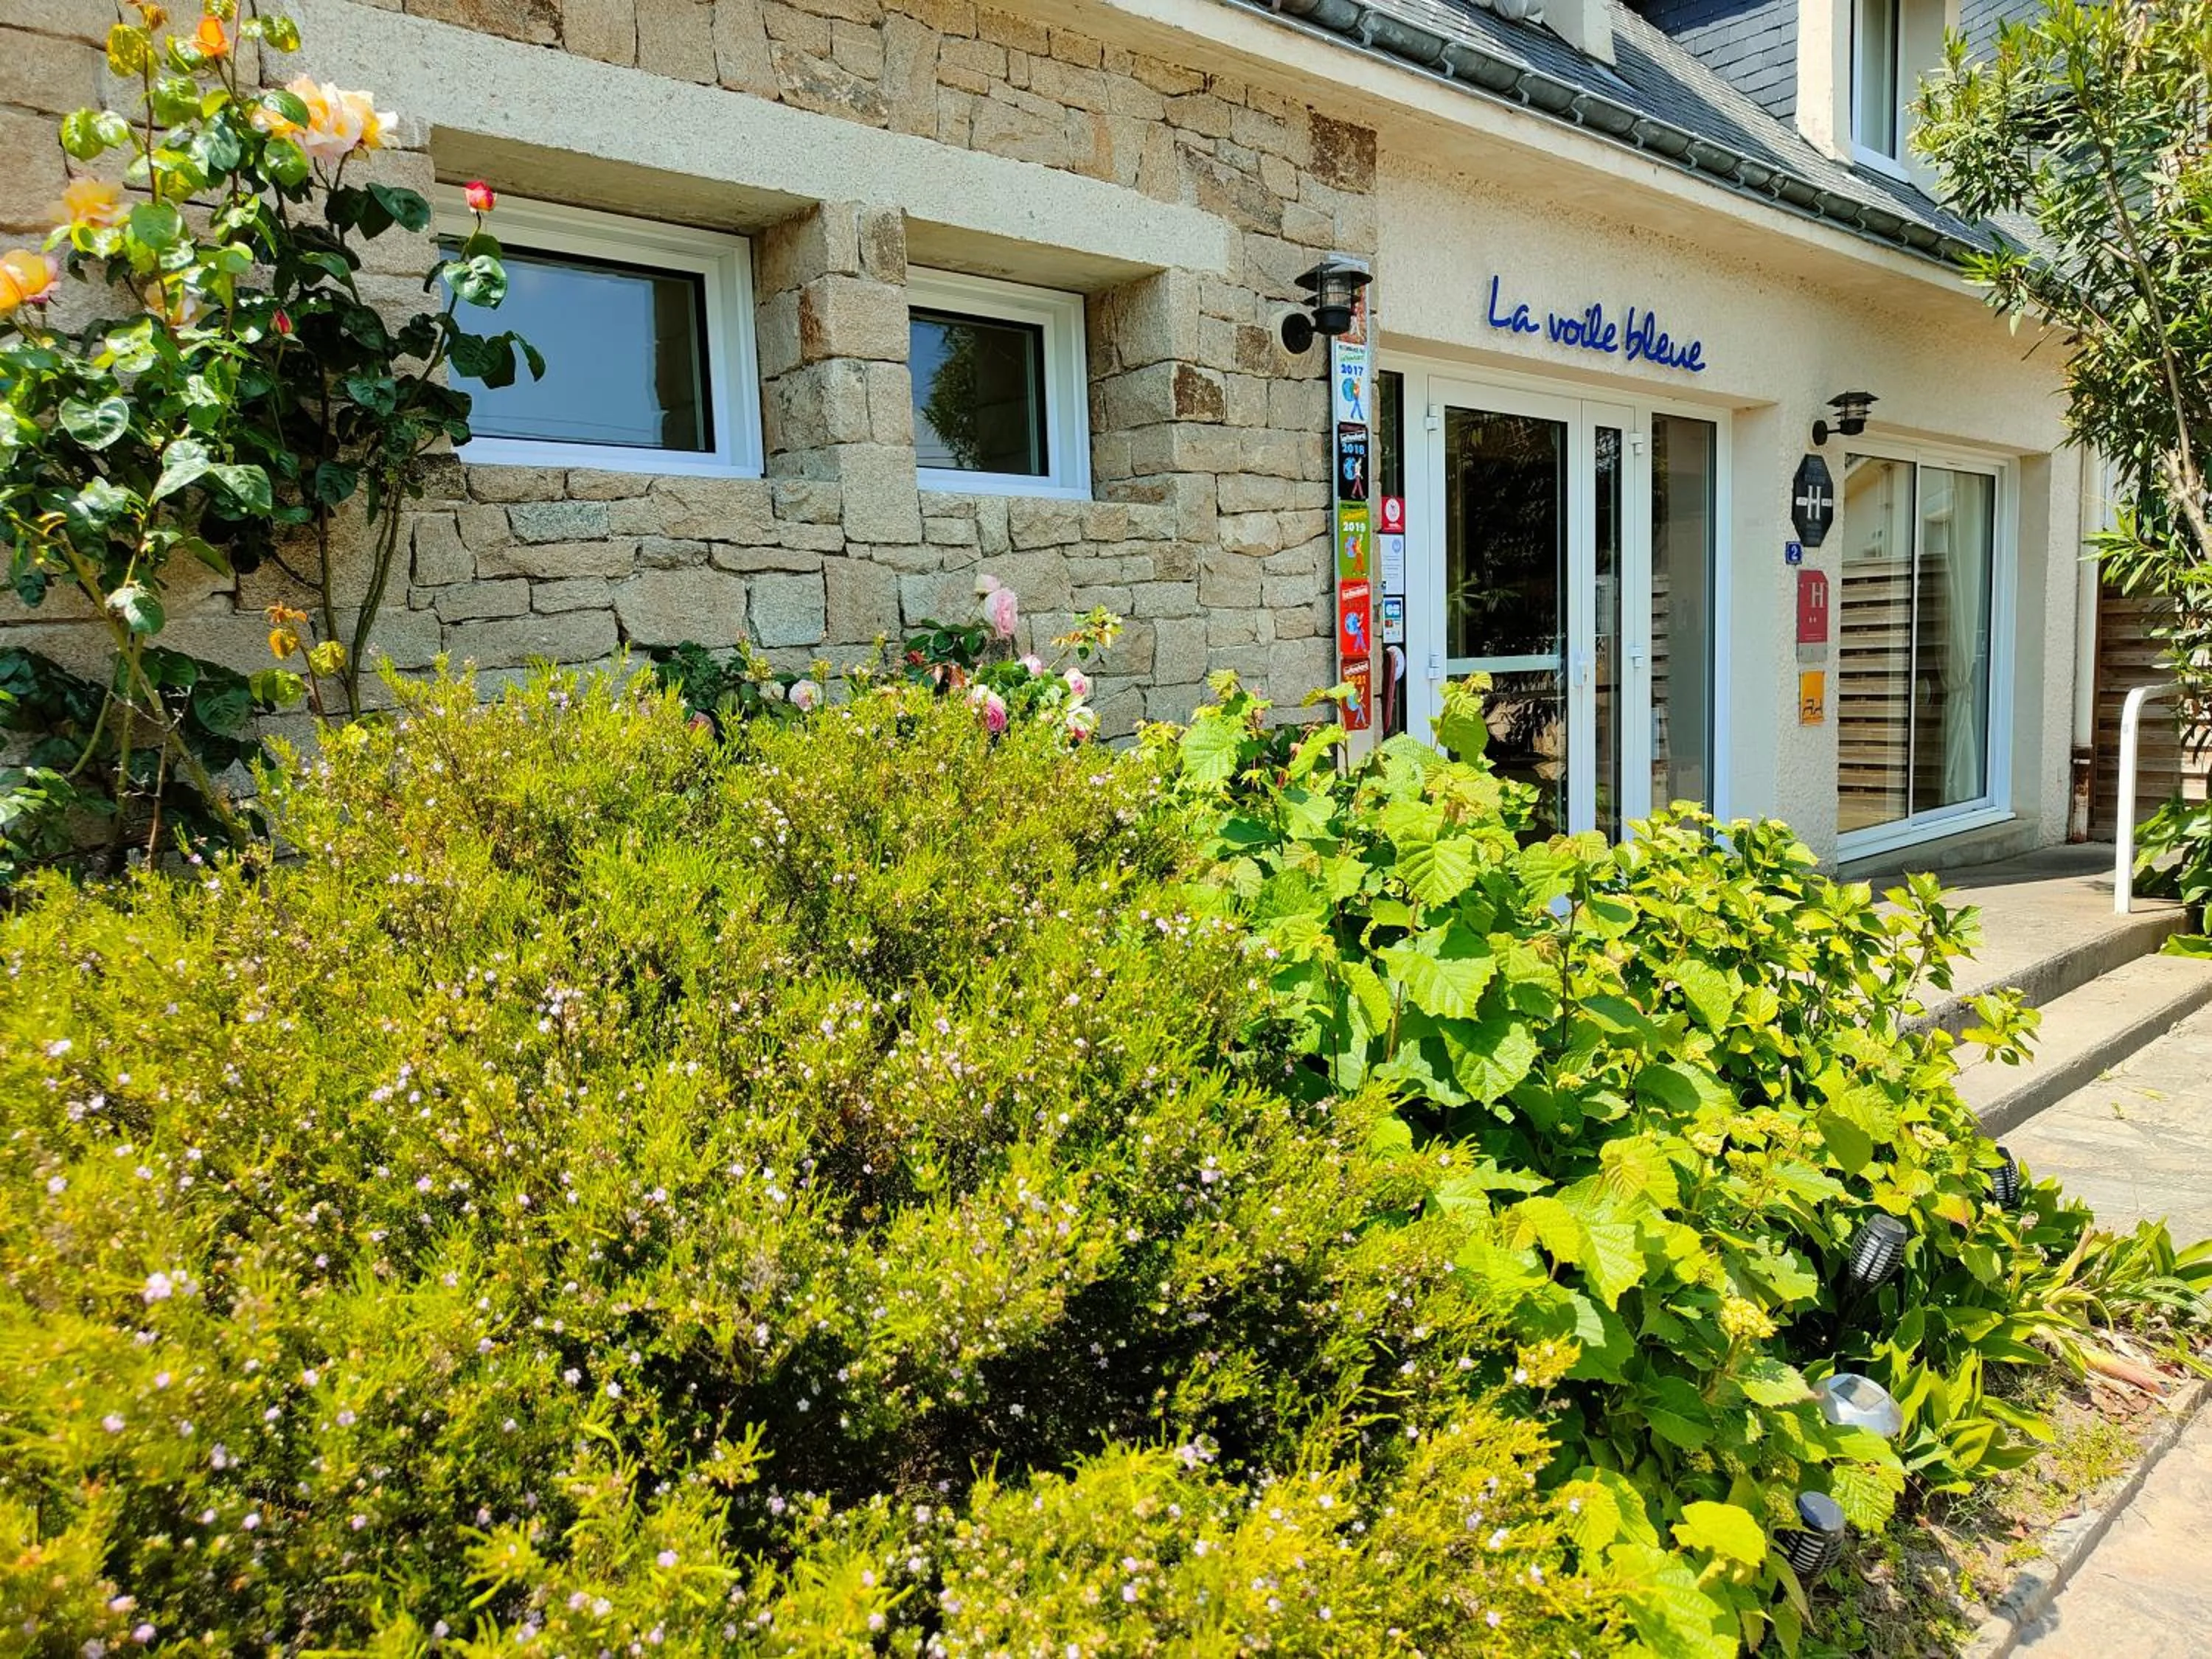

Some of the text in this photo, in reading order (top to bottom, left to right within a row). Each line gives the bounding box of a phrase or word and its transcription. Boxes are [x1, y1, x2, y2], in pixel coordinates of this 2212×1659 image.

[1489, 275, 1705, 372] La voile bleue
[1340, 364, 1364, 377] 2017
[1342, 442, 1365, 455] 2018
[1806, 485, 1822, 519] H
[1343, 521, 1366, 533] 2019
[1790, 545, 1798, 560] 2
[1809, 582, 1826, 608] H
